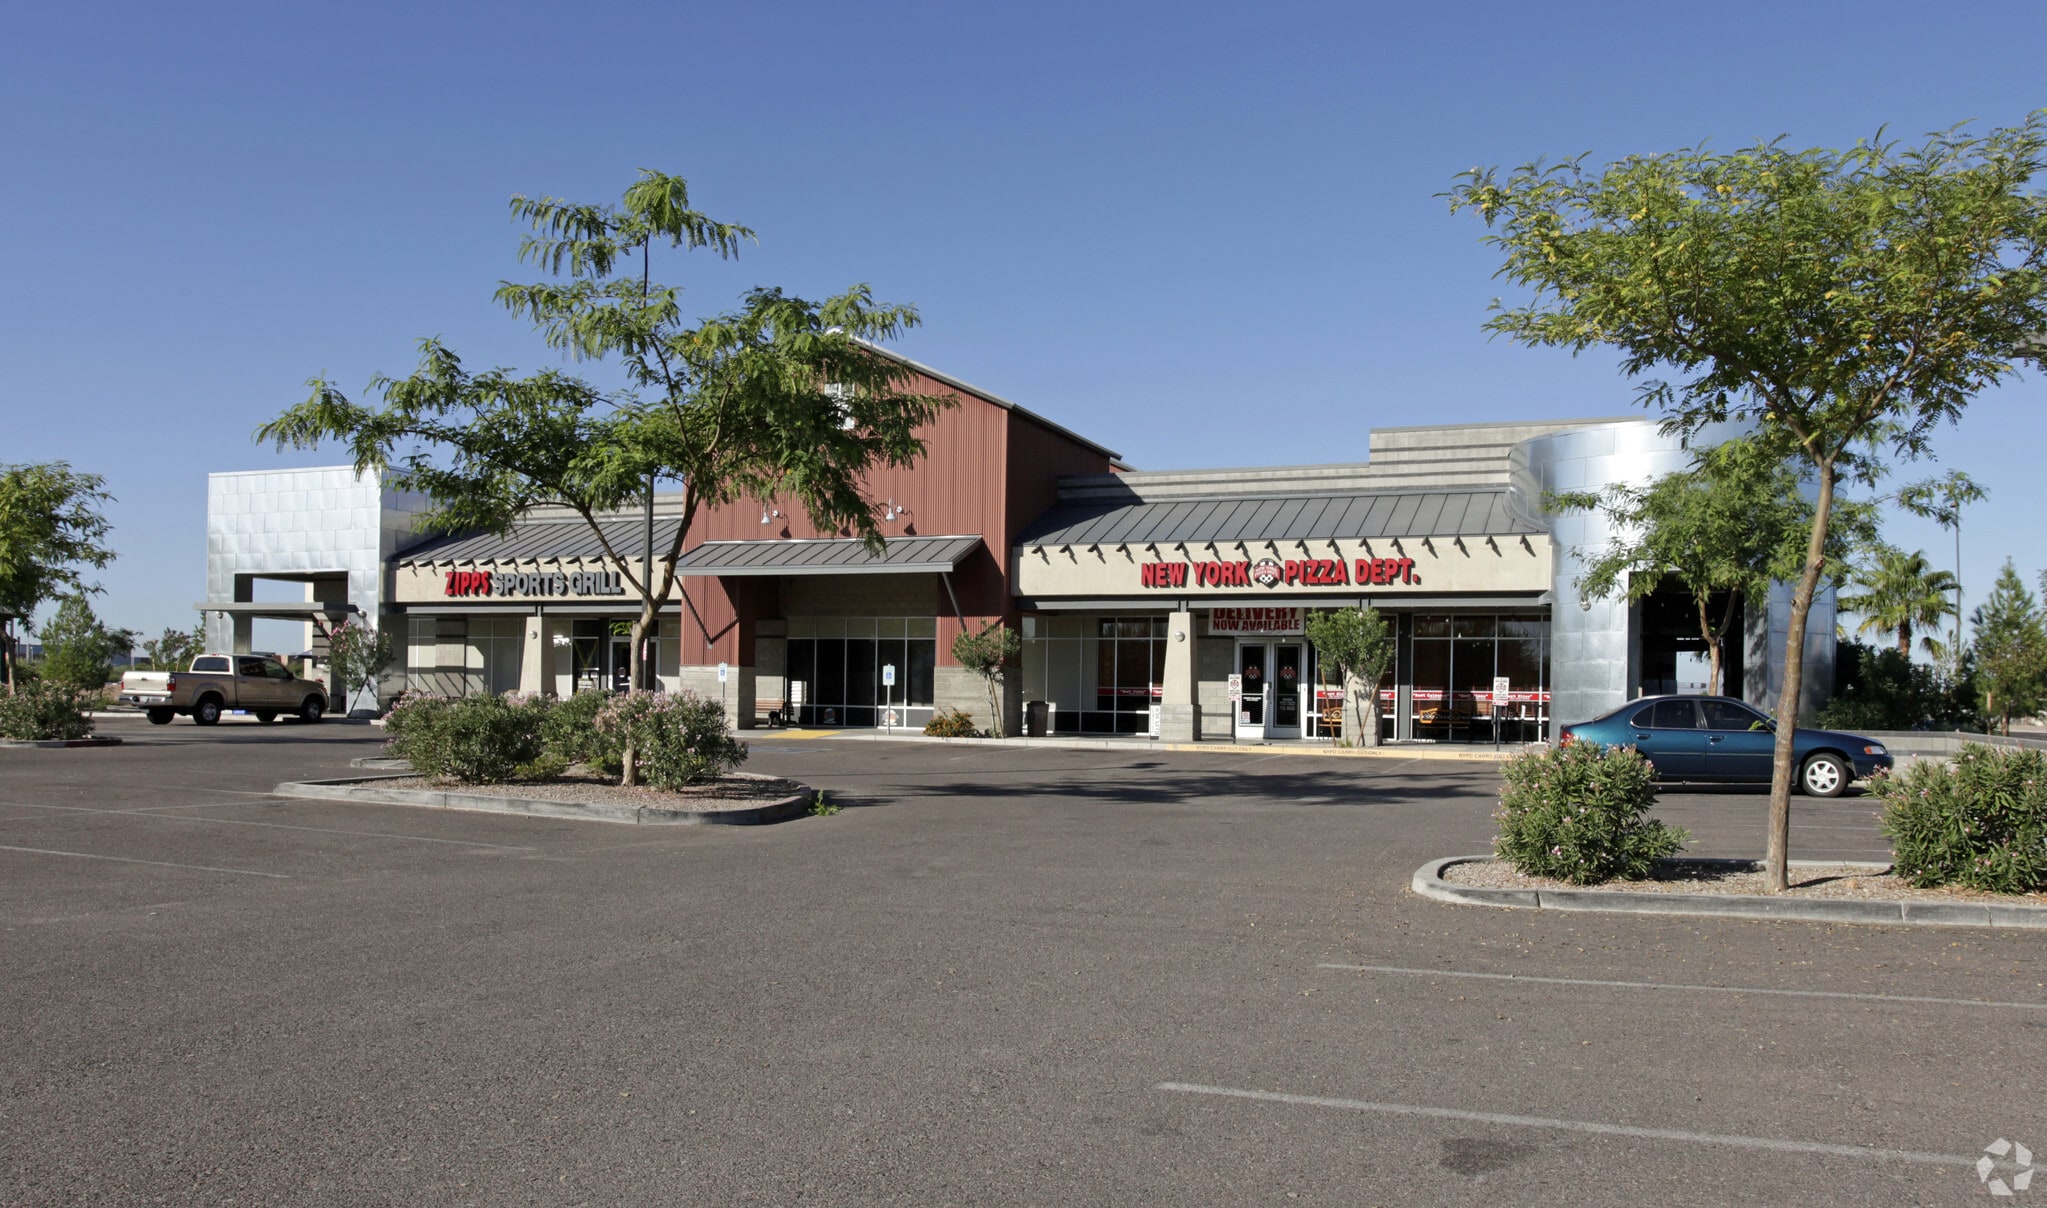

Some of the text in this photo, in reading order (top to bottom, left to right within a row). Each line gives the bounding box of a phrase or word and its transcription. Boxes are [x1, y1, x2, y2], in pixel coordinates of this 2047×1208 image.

[1141, 562, 1186, 588] NEW
[1192, 560, 1250, 587] YORK
[1285, 559, 1349, 586] PIZZA
[1355, 557, 1419, 585] DEPT.
[445, 571, 623, 596] ZIPPS SPORTS GRILL
[1213, 607, 1298, 620] DELIVERY
[1213, 619, 1300, 631] NOW AVAILABLE
